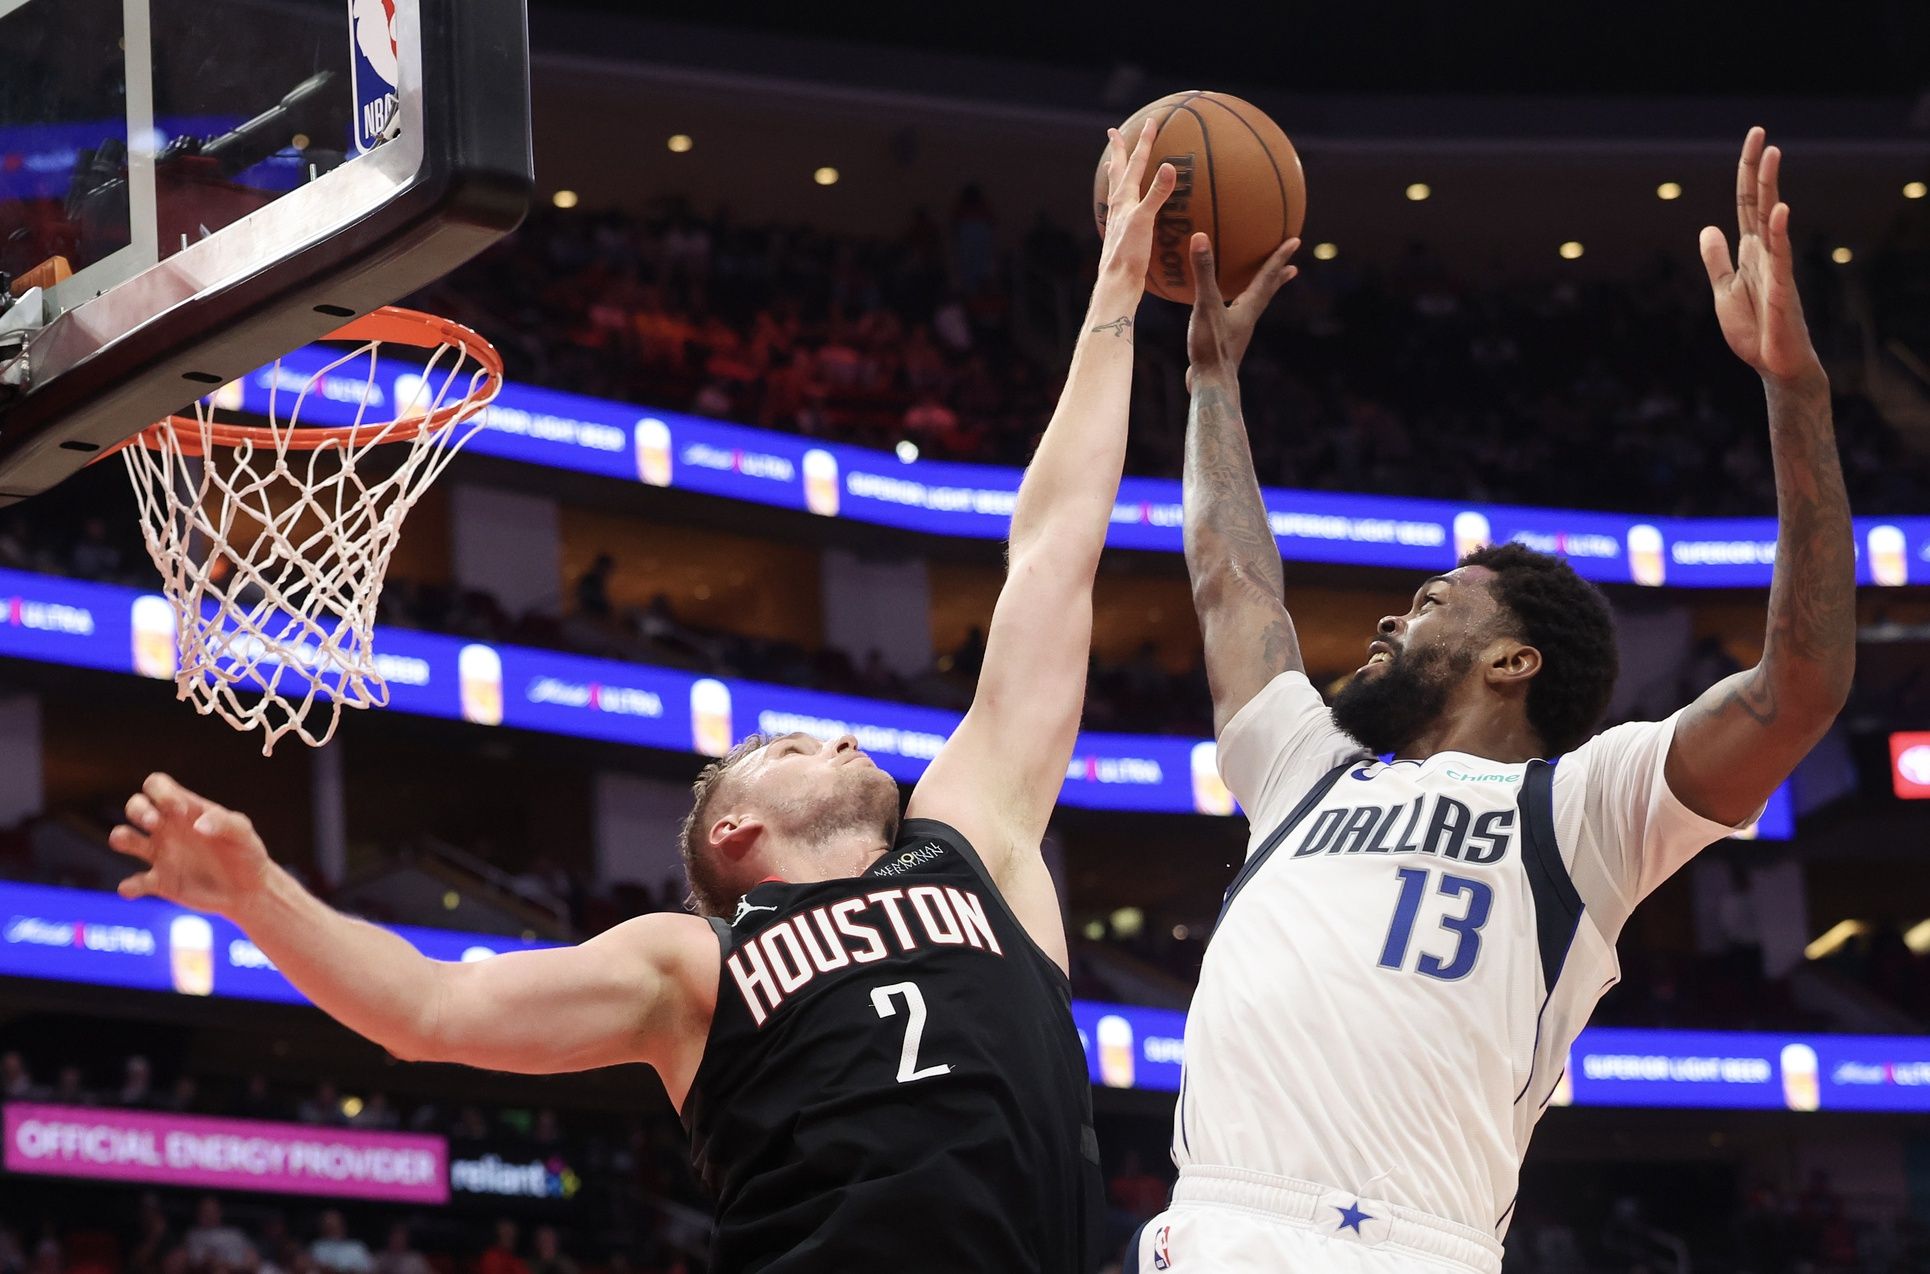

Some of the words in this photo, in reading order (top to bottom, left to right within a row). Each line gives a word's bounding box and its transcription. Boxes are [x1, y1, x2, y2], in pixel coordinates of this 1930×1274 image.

[873, 842, 940, 877] MEMORIAL
[882, 846, 944, 877] ERMANN
[1290, 792, 1517, 866] DALLAS
[726, 886, 1004, 1029] HOUSTON
[1376, 865, 1495, 982] 13
[868, 980, 953, 1084] 2
[16, 1119, 162, 1168] OFFICIAL
[164, 1131, 285, 1176] ENERGY
[286, 1141, 435, 1185] PROVIDER
[451, 1152, 548, 1198] reliant
